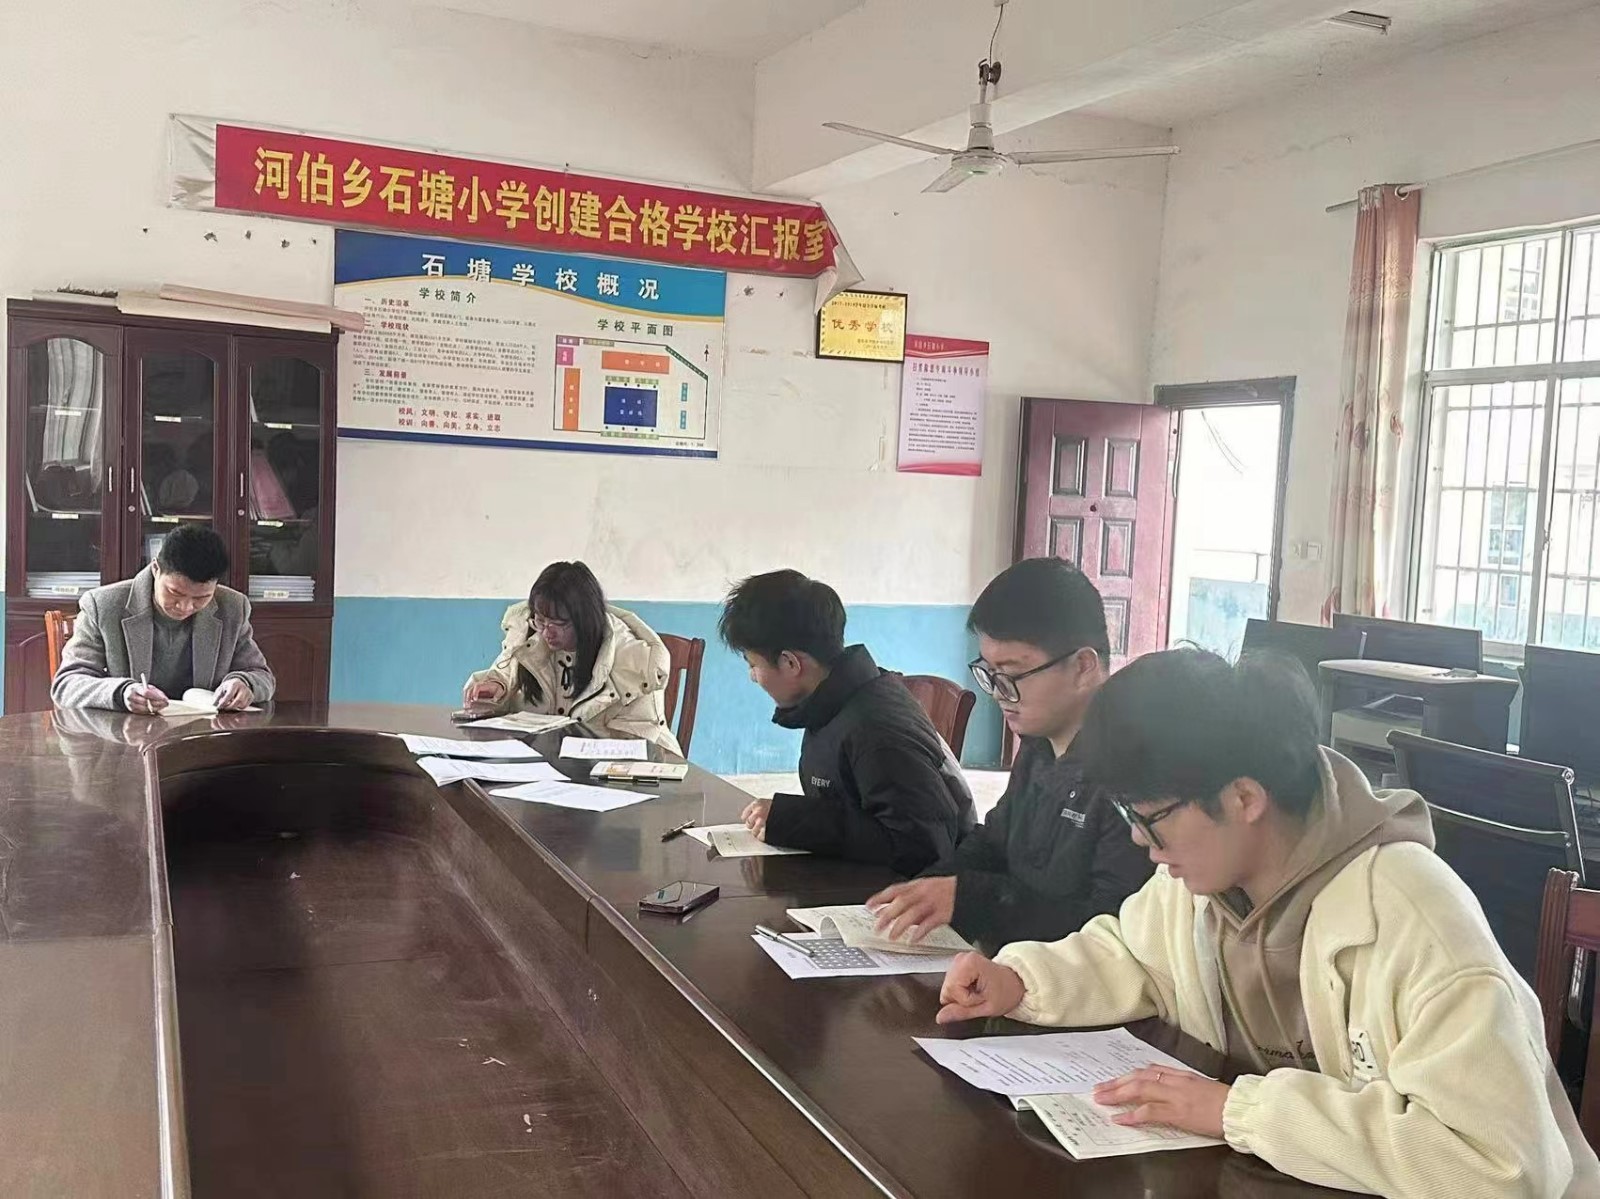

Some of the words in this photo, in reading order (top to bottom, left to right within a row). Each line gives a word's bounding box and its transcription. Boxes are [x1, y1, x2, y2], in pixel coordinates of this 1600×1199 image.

[254, 146, 828, 262] 河伯乡石塘小学创建合格学校汇报室
[421, 252, 660, 301] 石塘学校概况
[418, 287, 477, 304] 学校简介
[597, 318, 674, 337] 学校平面图
[831, 318, 894, 334] 优秀学校
